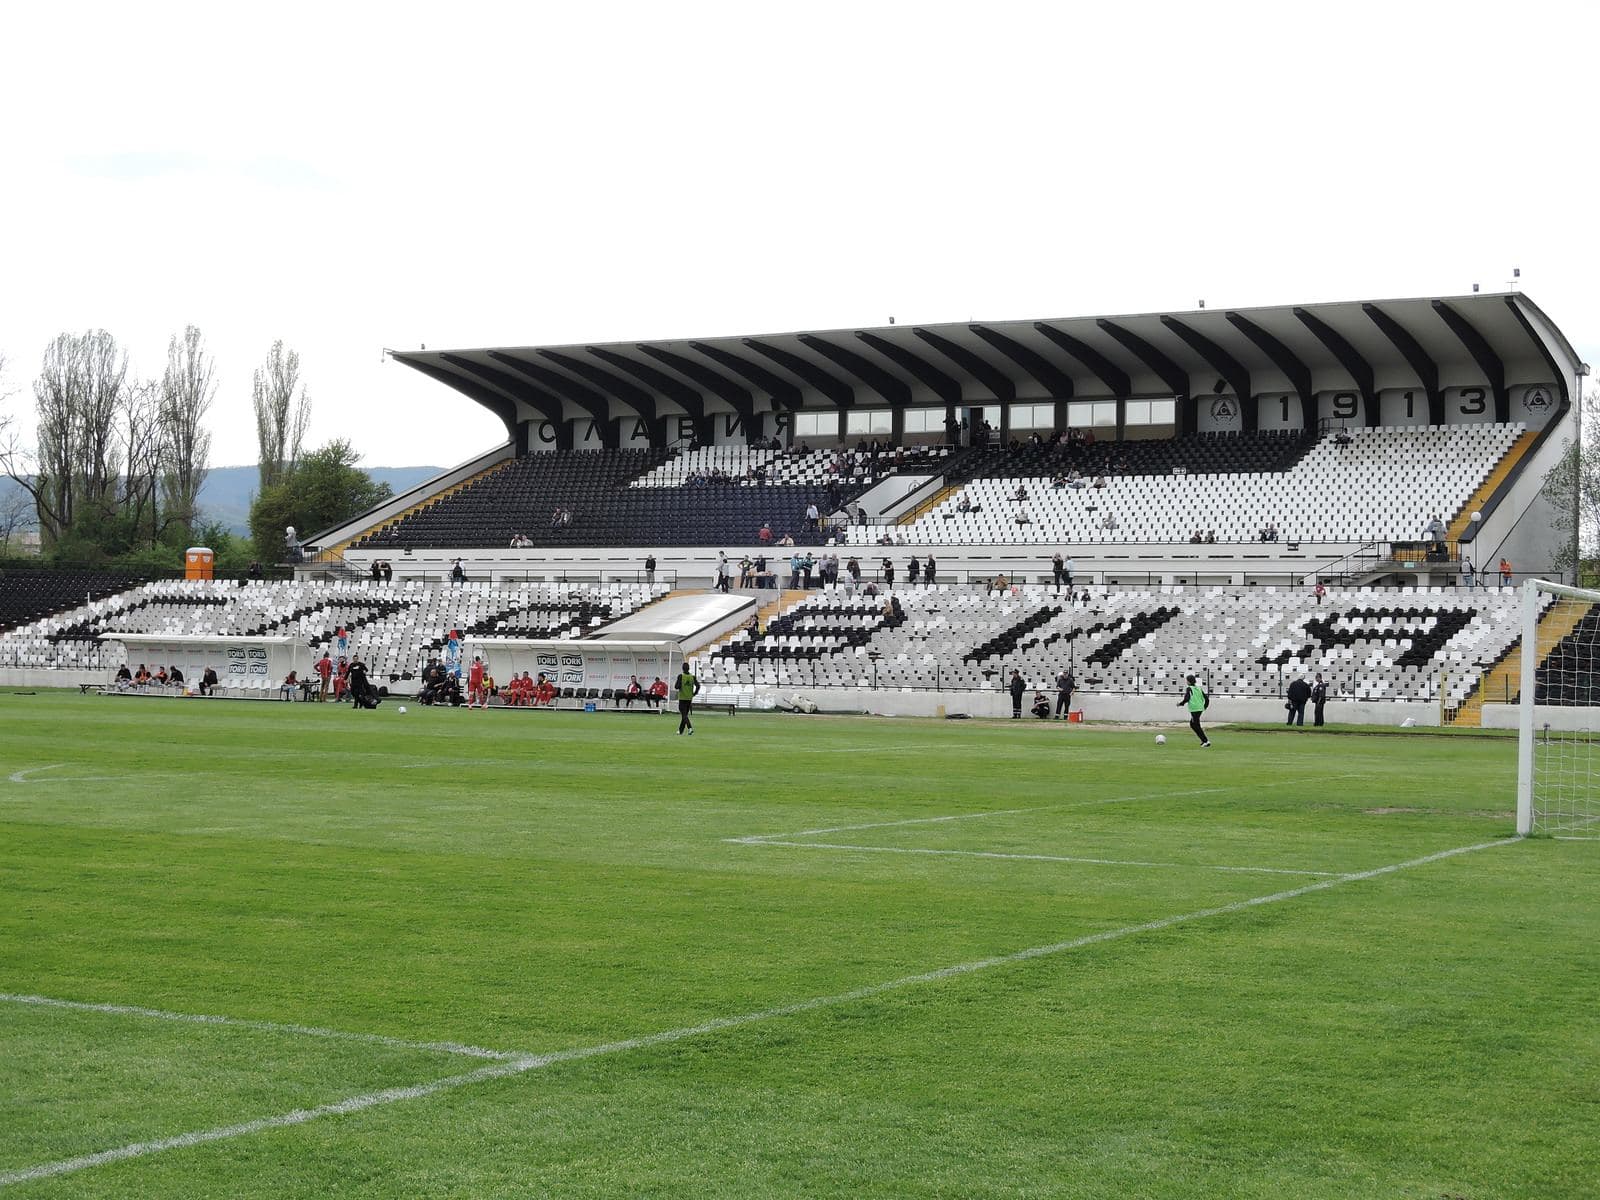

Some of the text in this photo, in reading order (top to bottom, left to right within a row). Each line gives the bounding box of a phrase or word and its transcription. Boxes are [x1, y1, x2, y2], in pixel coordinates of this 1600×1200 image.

[1279, 388, 1487, 422] 1913
[538, 656, 557, 665] TORK
[562, 656, 582, 665] TORK
[563, 673, 582, 682] TORK
